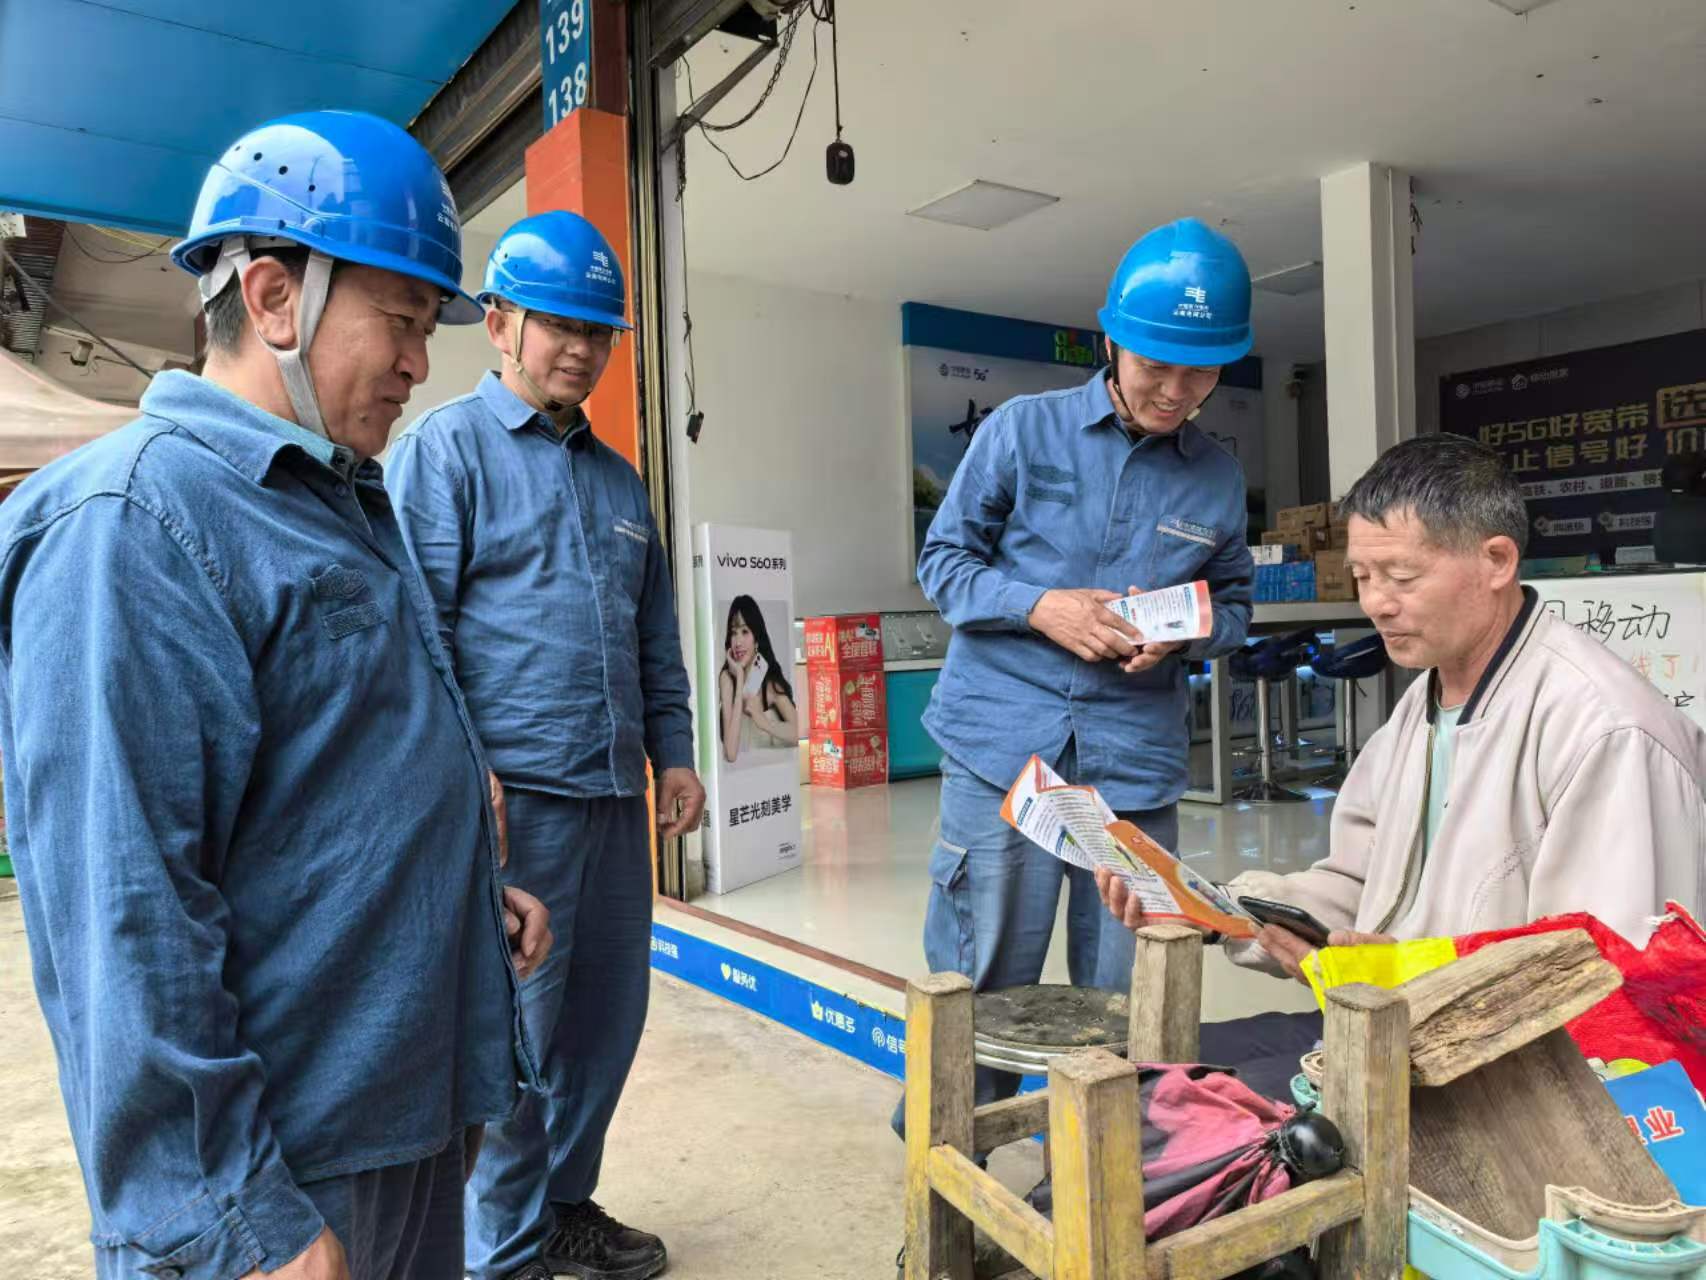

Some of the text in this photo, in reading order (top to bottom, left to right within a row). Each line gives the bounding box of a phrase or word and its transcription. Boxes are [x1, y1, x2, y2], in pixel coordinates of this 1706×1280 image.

[546, 0, 584, 64] 139
[549, 62, 587, 127] 138
[1500, 434, 1649, 472] 止信号好
[717, 552, 747, 568] vivo
[728, 794, 792, 828] 星芒光刻美学
[825, 1007, 856, 1034] 优惠多
